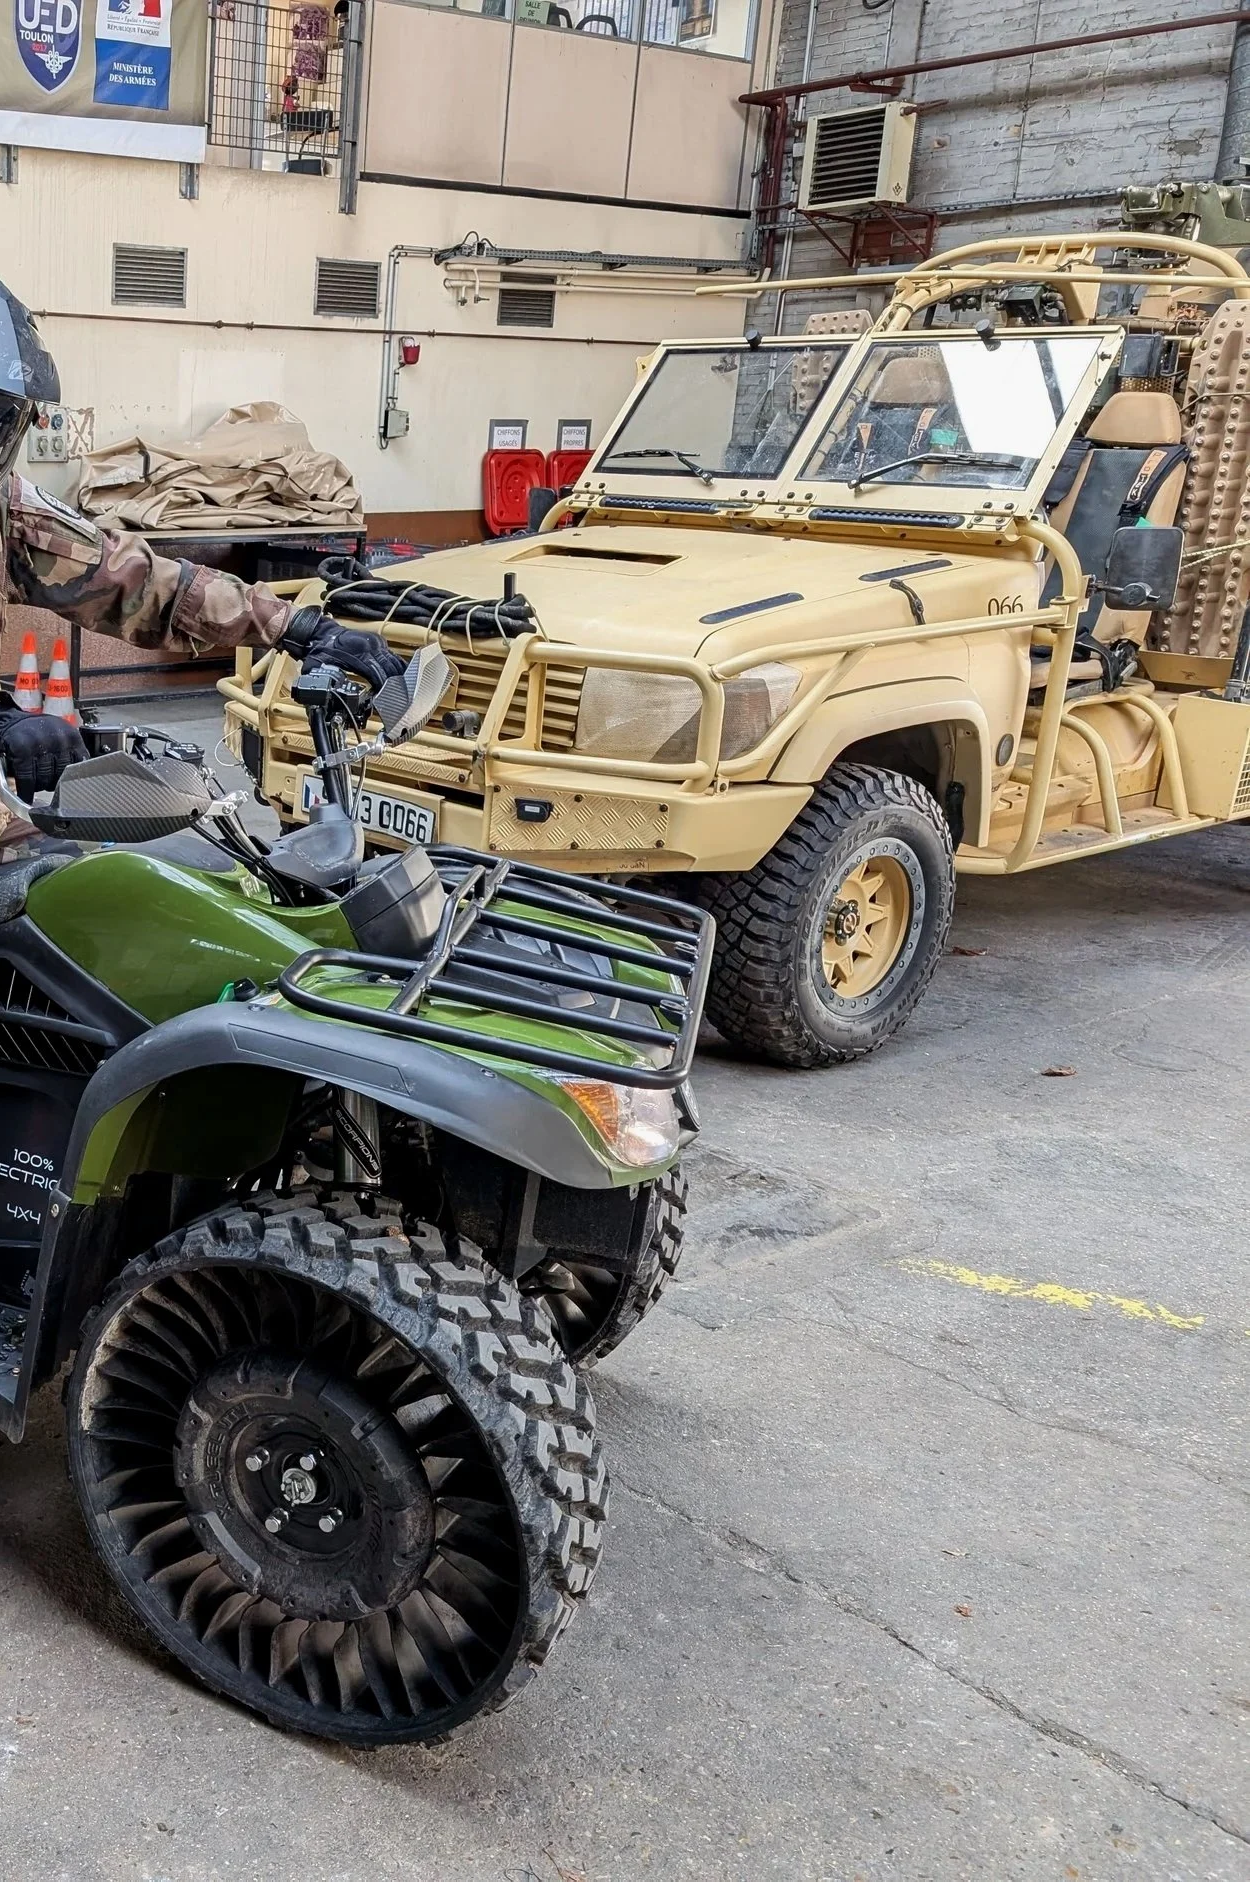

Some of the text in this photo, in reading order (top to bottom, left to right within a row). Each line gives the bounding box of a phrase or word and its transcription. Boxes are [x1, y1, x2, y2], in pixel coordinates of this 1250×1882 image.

[525, 1, 541, 9] SALLE
[18, 0, 78, 34] UED
[20, 30, 53, 43] TOULON
[113, 62, 154, 75] MINISTÈRE
[109, 74, 156, 87] DES ARMÉES
[497, 428, 521, 436] CHIFFONS
[563, 428, 586, 436] CHIFFONS
[498, 439, 518, 447] USAGÉS
[988, 595, 1023, 616] 066
[379, 801, 428, 843] 0066
[335, 1109, 379, 1171] SCORPIONS
[14, 1148, 54, 1172] 100%
[6, 1203, 42, 1225] 4X4
